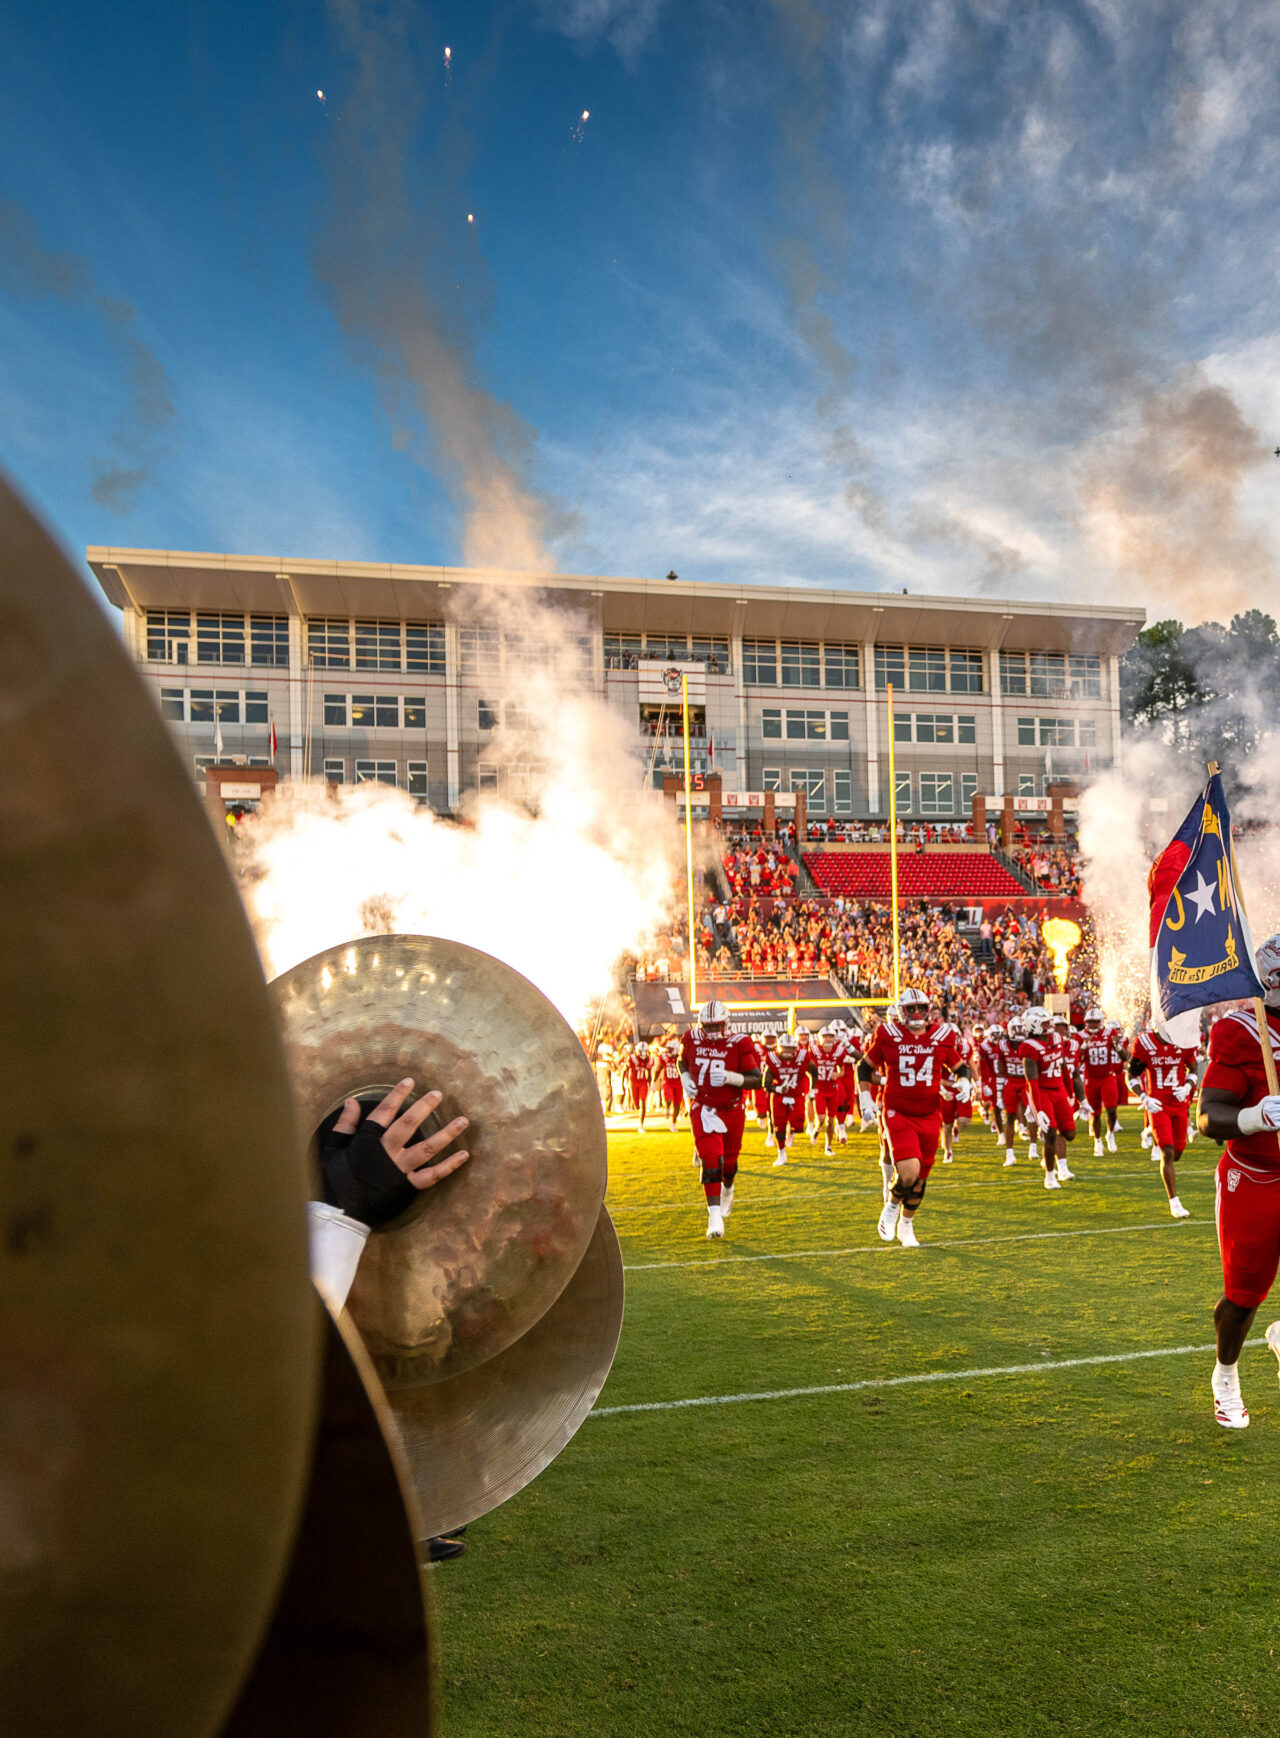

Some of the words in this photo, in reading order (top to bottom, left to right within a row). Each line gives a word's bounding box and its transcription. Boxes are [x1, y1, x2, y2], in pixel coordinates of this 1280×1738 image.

[696, 1047, 708, 1056] NC
[898, 1045, 914, 1054] NC
[914, 1045, 934, 1054] State
[1151, 1057, 1164, 1065] NC
[899, 1056, 934, 1087] 54
[1154, 1066, 1179, 1089] 14
[779, 1074, 798, 1090] 74
